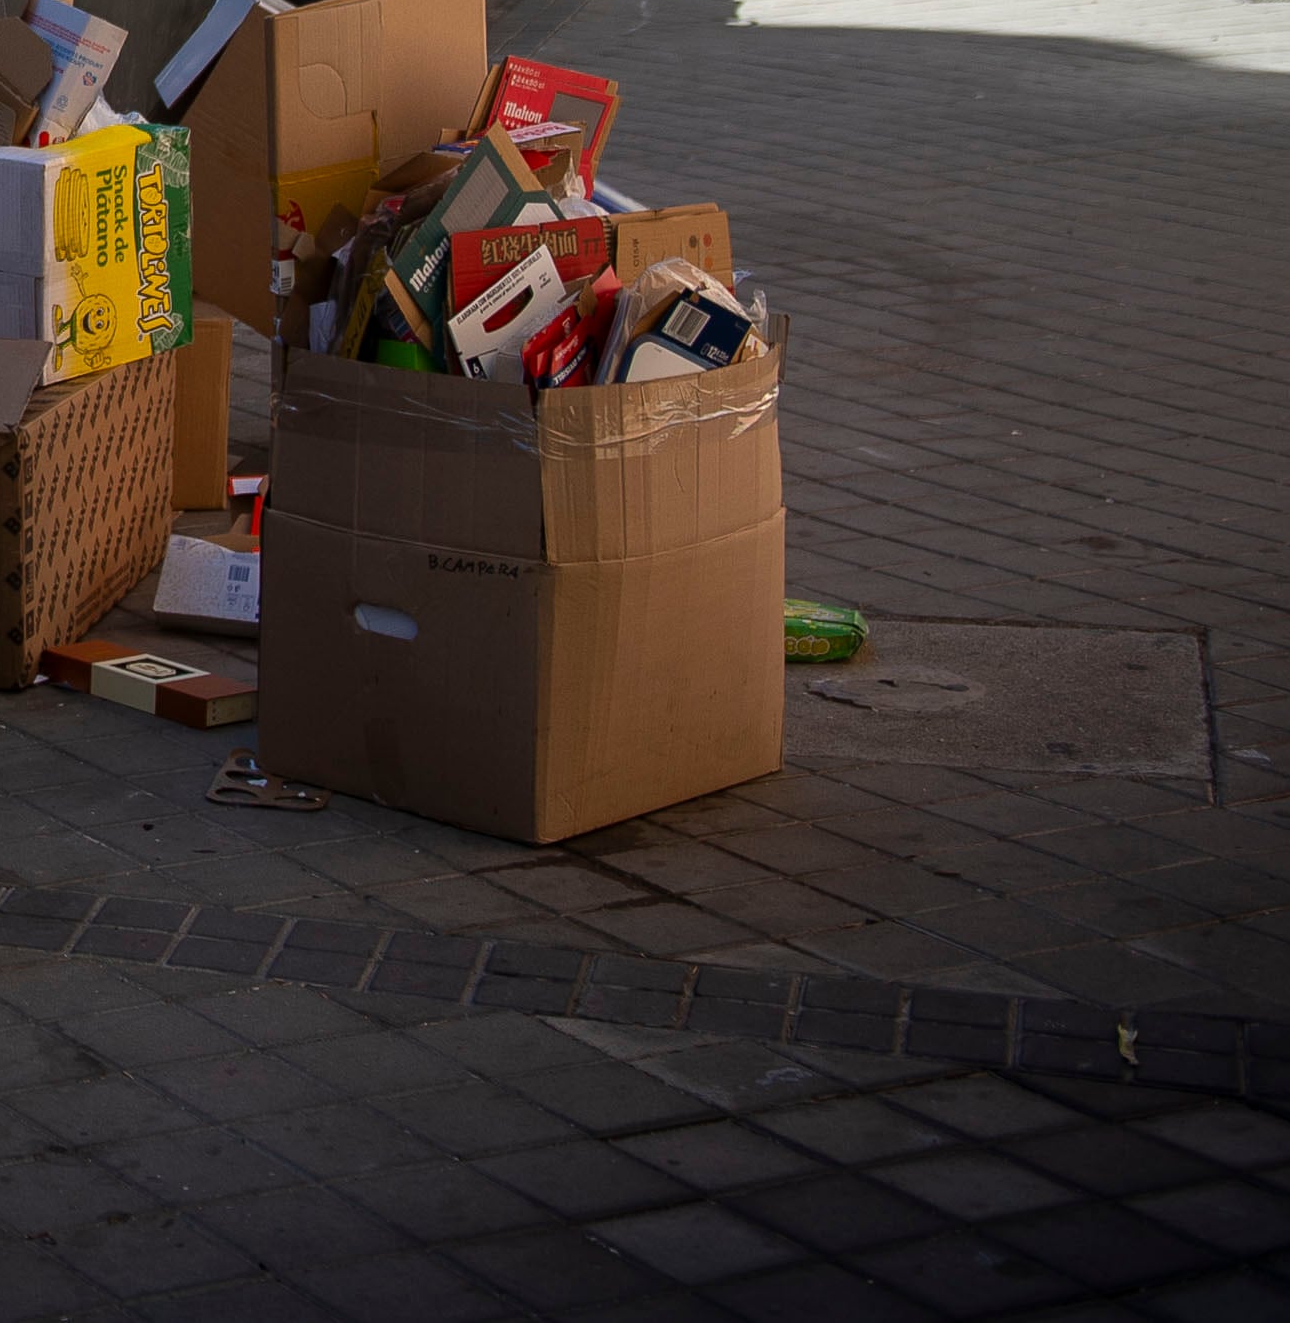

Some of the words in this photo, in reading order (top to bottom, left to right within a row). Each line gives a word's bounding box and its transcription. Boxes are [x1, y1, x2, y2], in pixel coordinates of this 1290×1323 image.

[96, 167, 113, 268] Plátano
[114, 165, 129, 232] Snack
[114, 236, 129, 263] de
